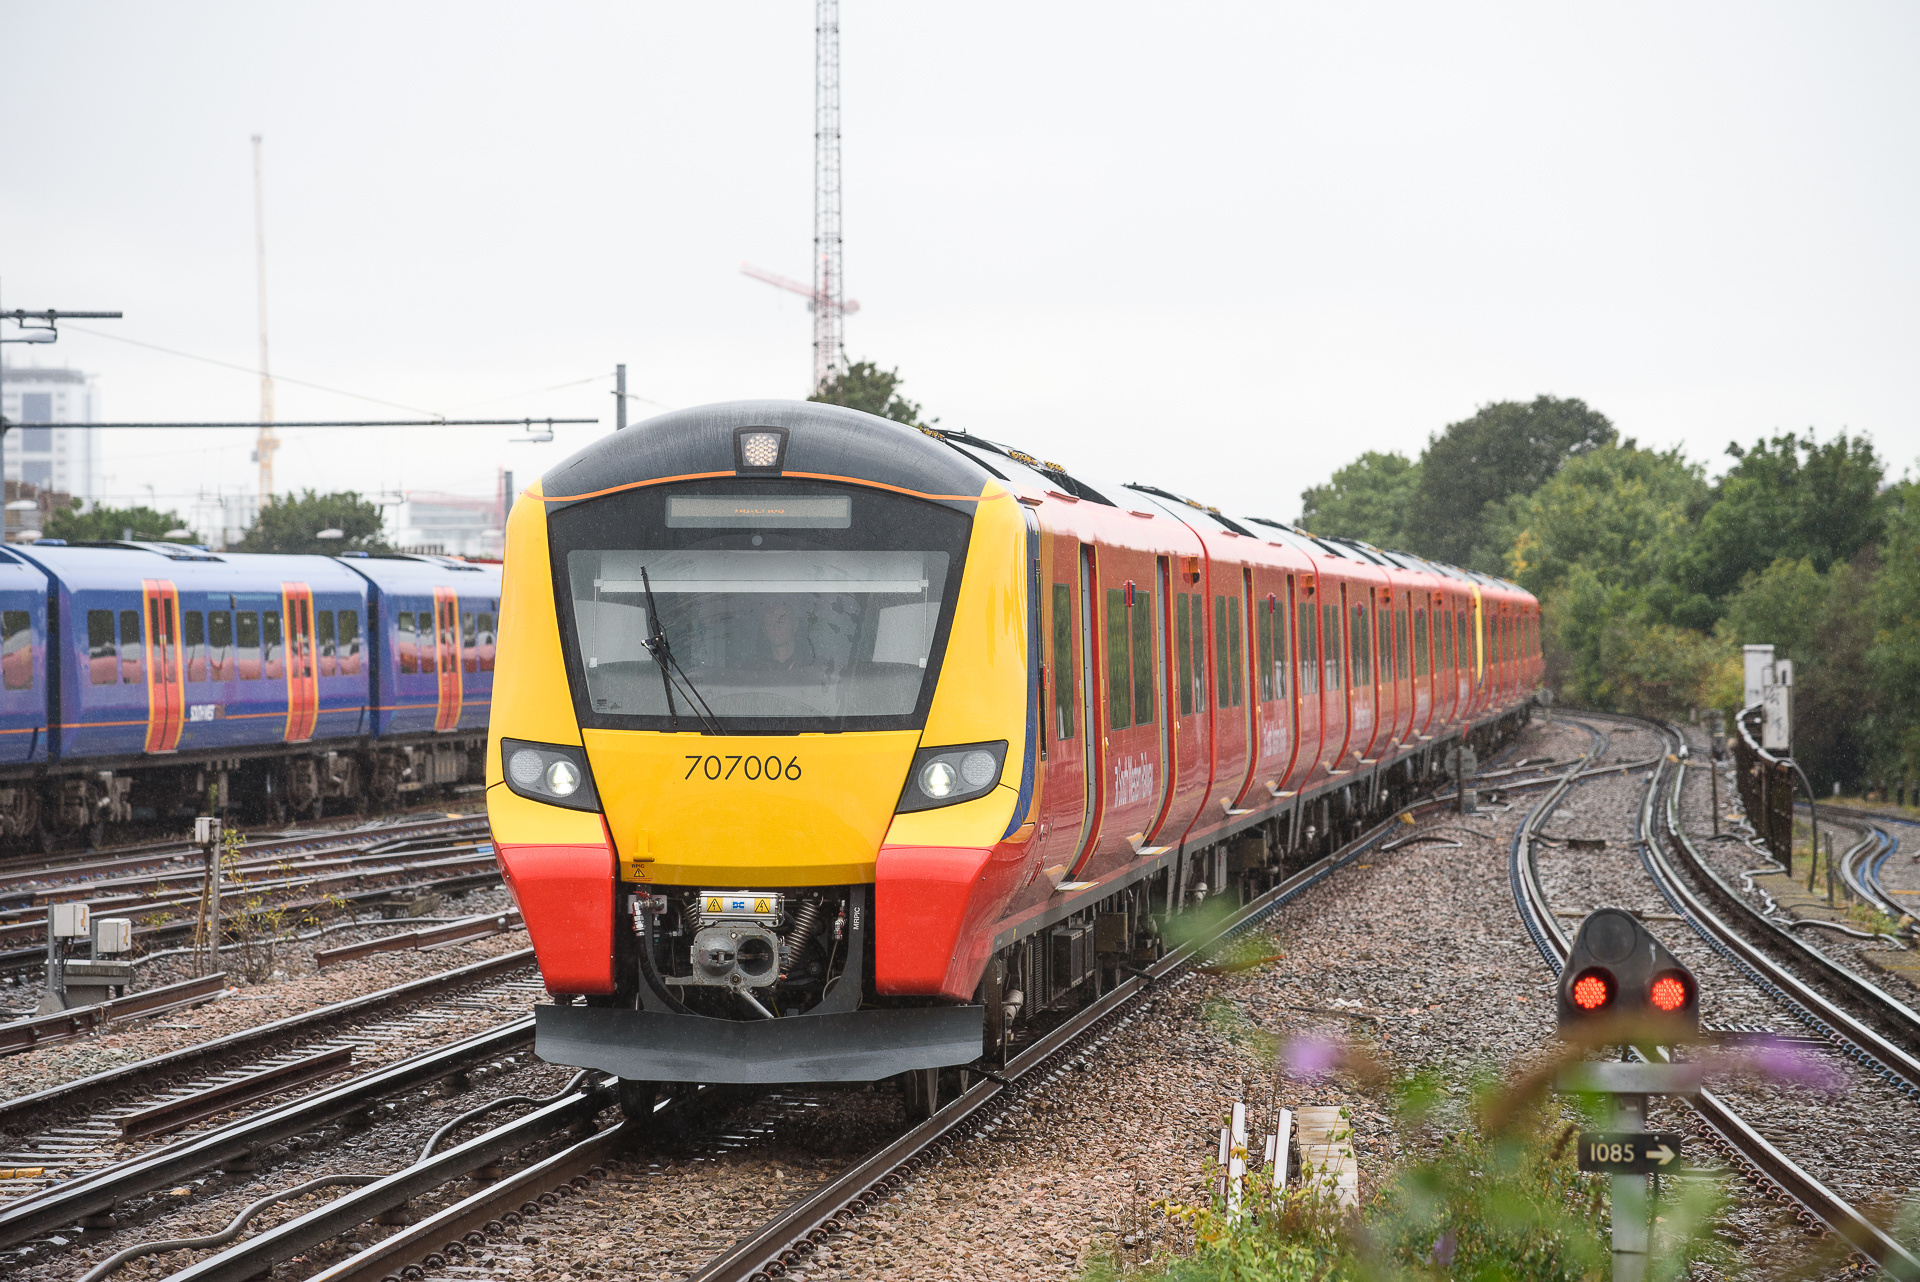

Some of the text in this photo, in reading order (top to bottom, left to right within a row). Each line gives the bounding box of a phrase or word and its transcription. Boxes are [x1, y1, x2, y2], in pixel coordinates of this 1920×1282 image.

[685, 755, 802, 781] 707006
[853, 906, 861, 931] MRPIC
[1590, 1143, 1635, 1162] 1085
